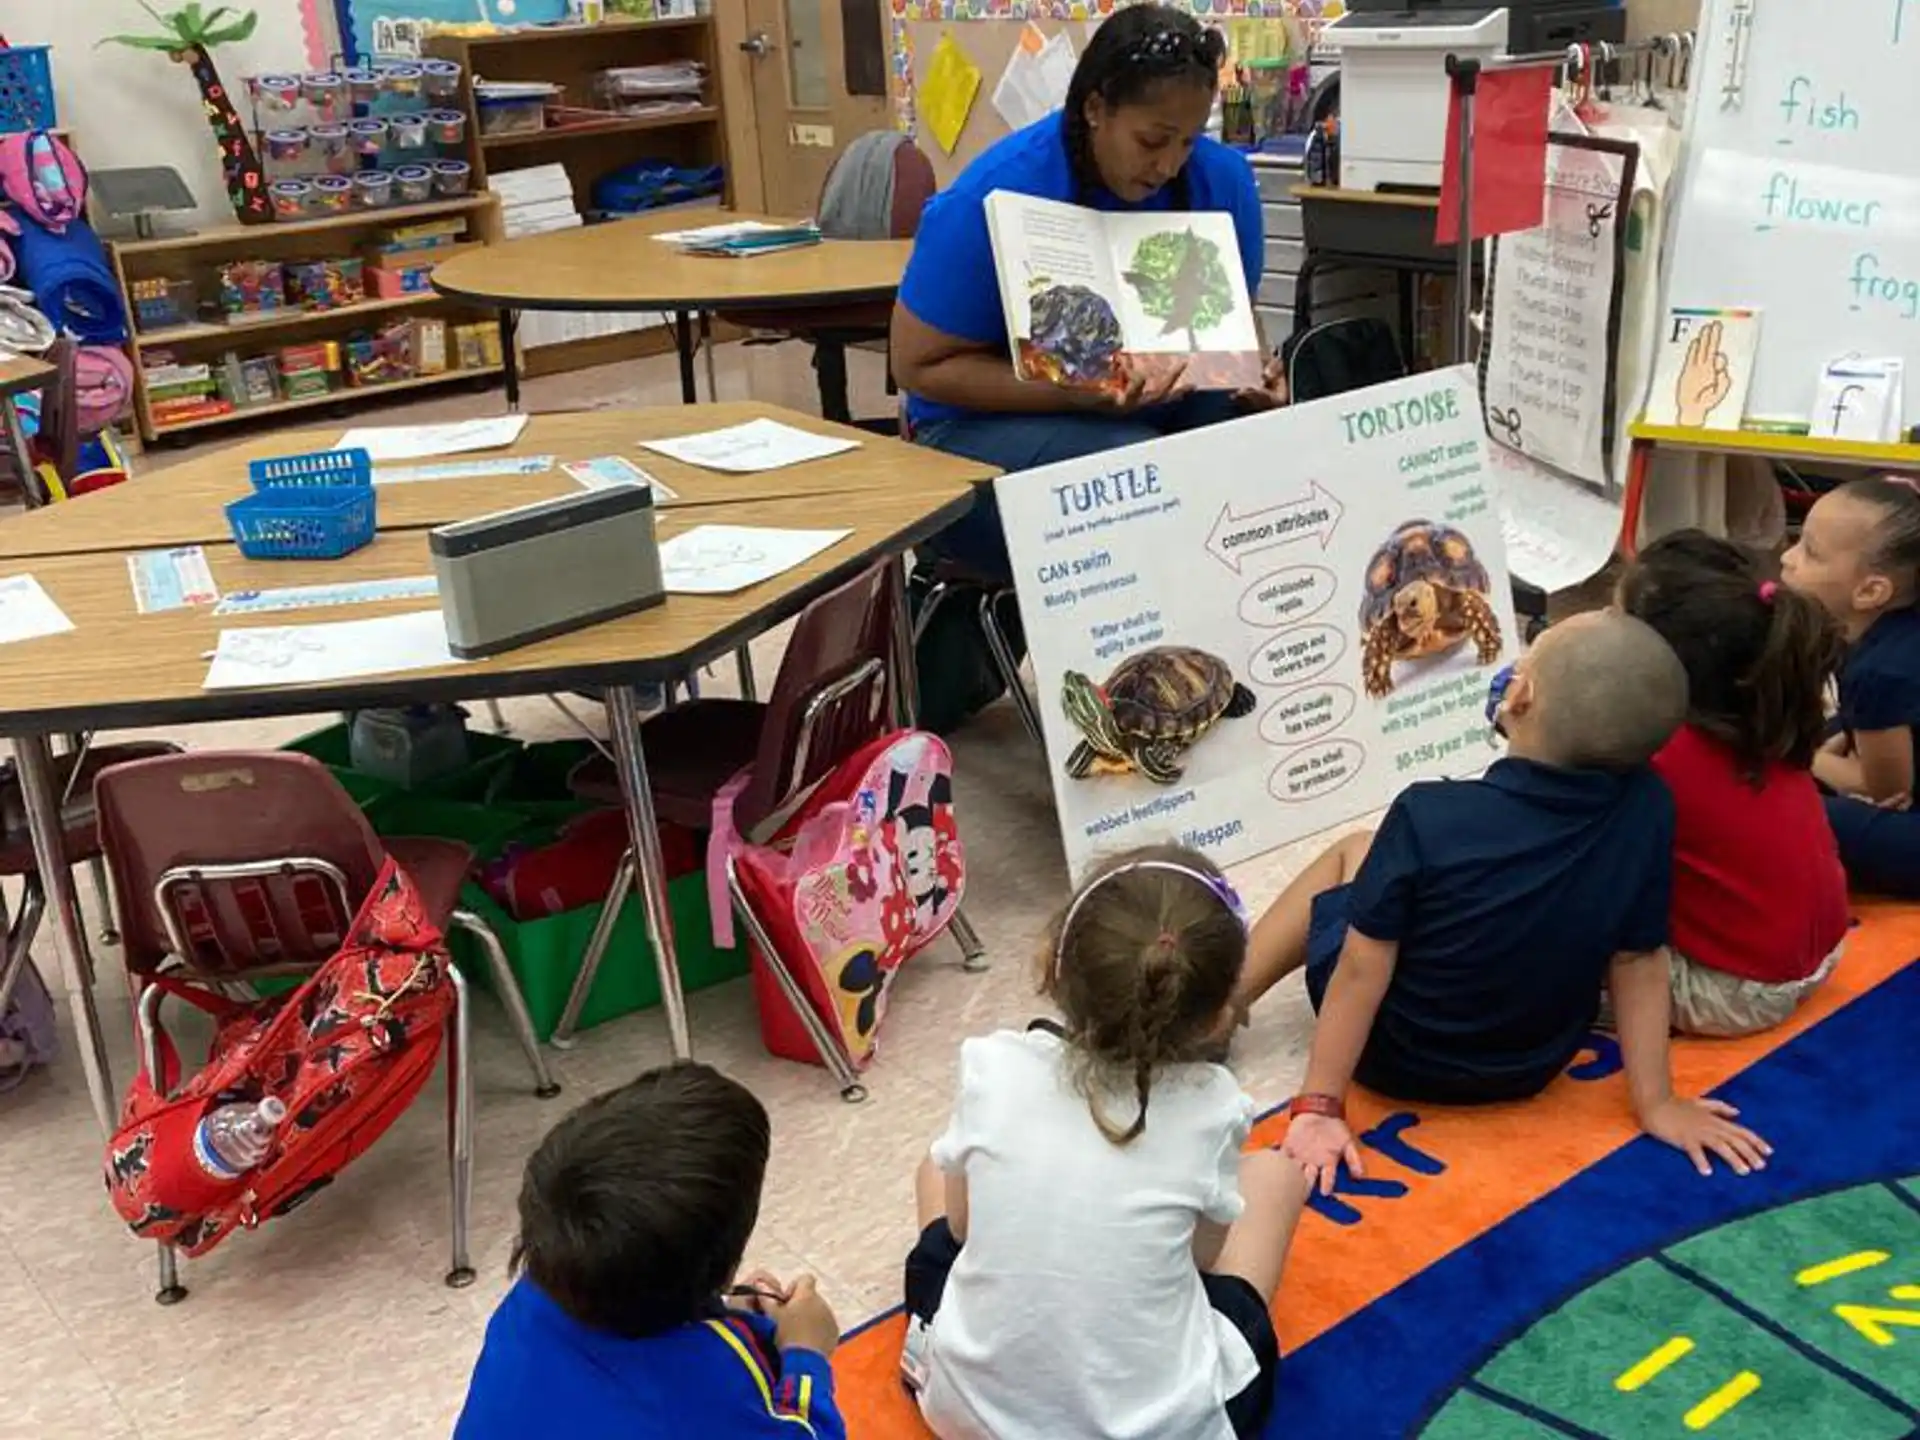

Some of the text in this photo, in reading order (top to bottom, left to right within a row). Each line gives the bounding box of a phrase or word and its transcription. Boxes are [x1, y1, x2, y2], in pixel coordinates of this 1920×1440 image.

[1779, 75, 1859, 130] fish
[1760, 172, 1881, 227] flower
[1849, 252, 1919, 319] frog
[1669, 317, 1691, 343] F
[1341, 389, 1459, 443] TORTOISE
[1832, 384, 1864, 436] f
[1399, 440, 1479, 472] CANNOT swim
[1052, 464, 1161, 515] TURTLE
[1222, 508, 1329, 550] common attributes
[1037, 551, 1112, 584] CAN swim
[1258, 574, 1315, 602] cold-blooded
[1302, 766, 1347, 791] protection
[1085, 810, 1129, 837] webbed
[1181, 818, 1244, 848] lifespan
